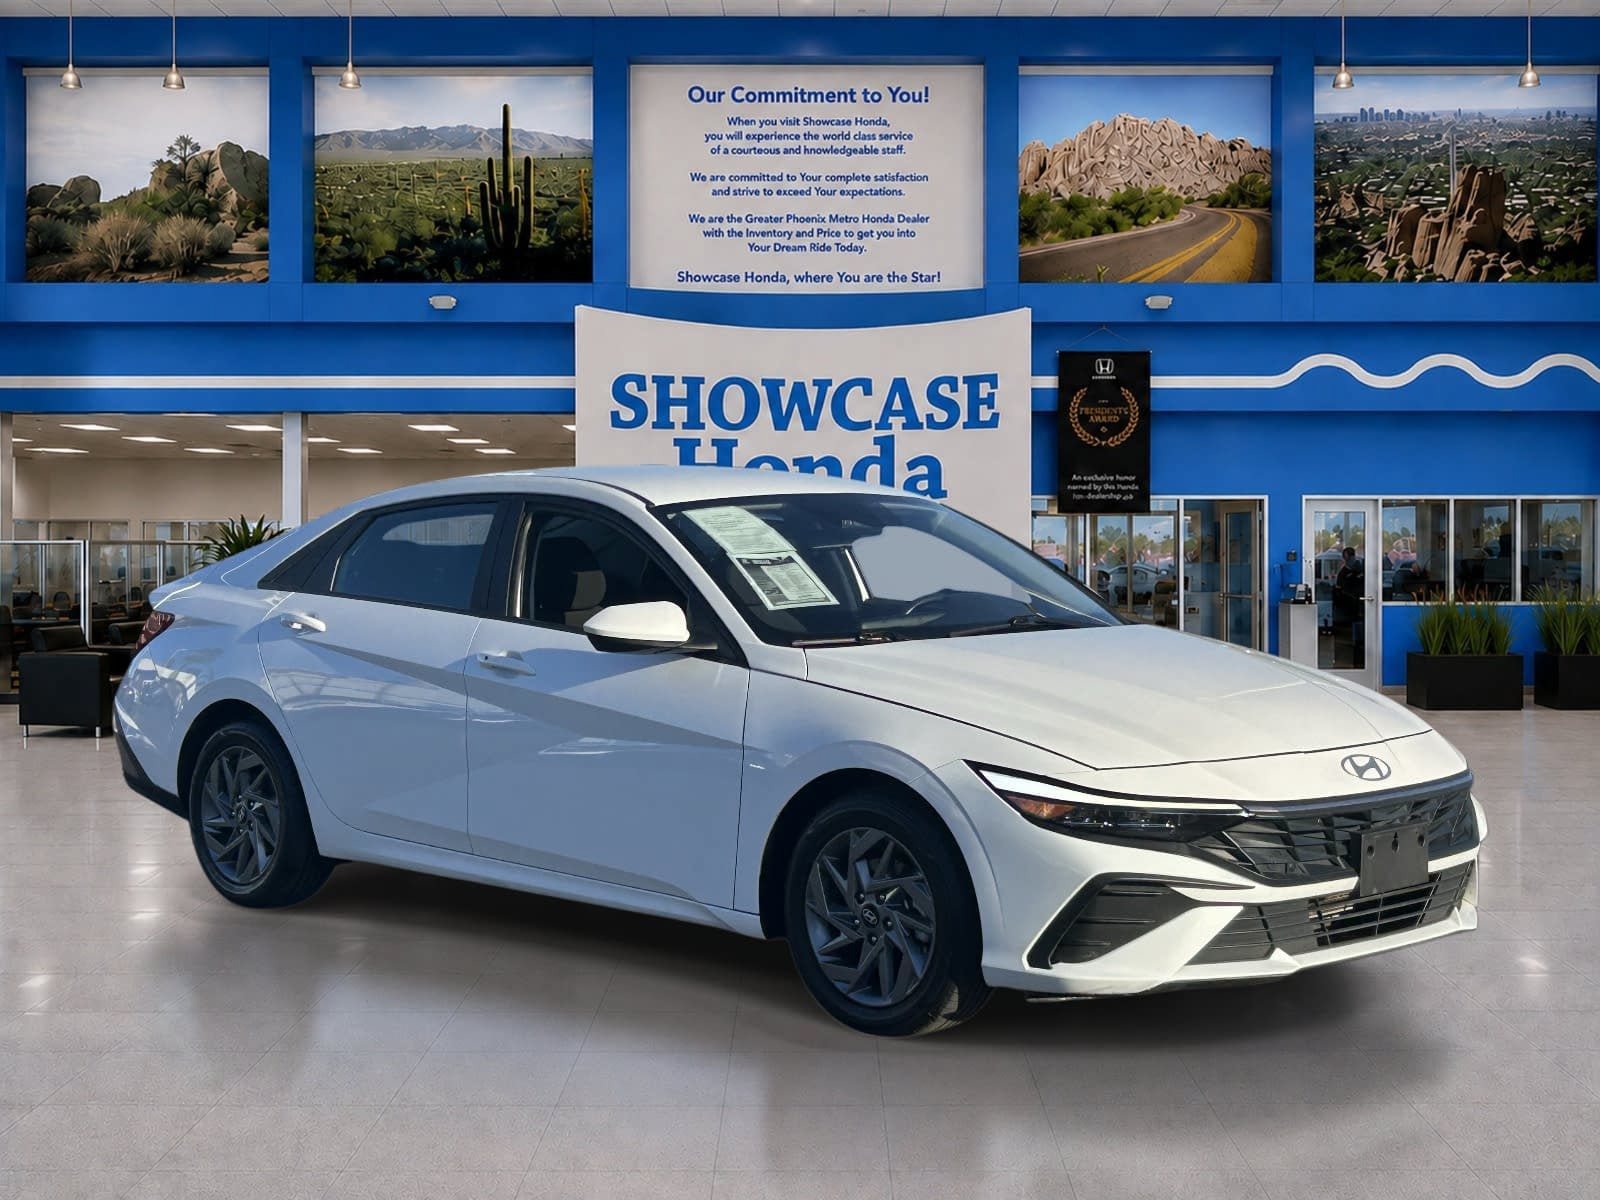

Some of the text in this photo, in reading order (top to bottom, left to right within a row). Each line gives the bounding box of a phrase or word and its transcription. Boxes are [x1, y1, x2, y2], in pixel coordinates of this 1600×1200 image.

[687, 85, 930, 104] Our Commitment to You!
[726, 115, 891, 129] When you visit Showcase Honda,
[704, 132, 724, 144] you
[724, 130, 744, 141] will
[744, 130, 802, 144] experience
[802, 130, 820, 141] the
[852, 130, 877, 142] class
[878, 130, 914, 142] service
[709, 144, 722, 155] of
[730, 146, 782, 156] courteous
[782, 144, 802, 155] and
[689, 171, 929, 186] We are committed to Your complete satisfaction
[711, 185, 906, 200] and strive to exceed Your expectations.
[688, 213, 931, 224] We are the Greater Phoenix Metro Honda Dealer
[702, 227, 917, 241] with the Inventory and Price to get you into
[747, 242, 868, 255] Your Dream Ride Today.
[676, 270, 941, 286] Showcase Honda, where You are the Star!
[610, 373, 1000, 431] SHOWCASE
